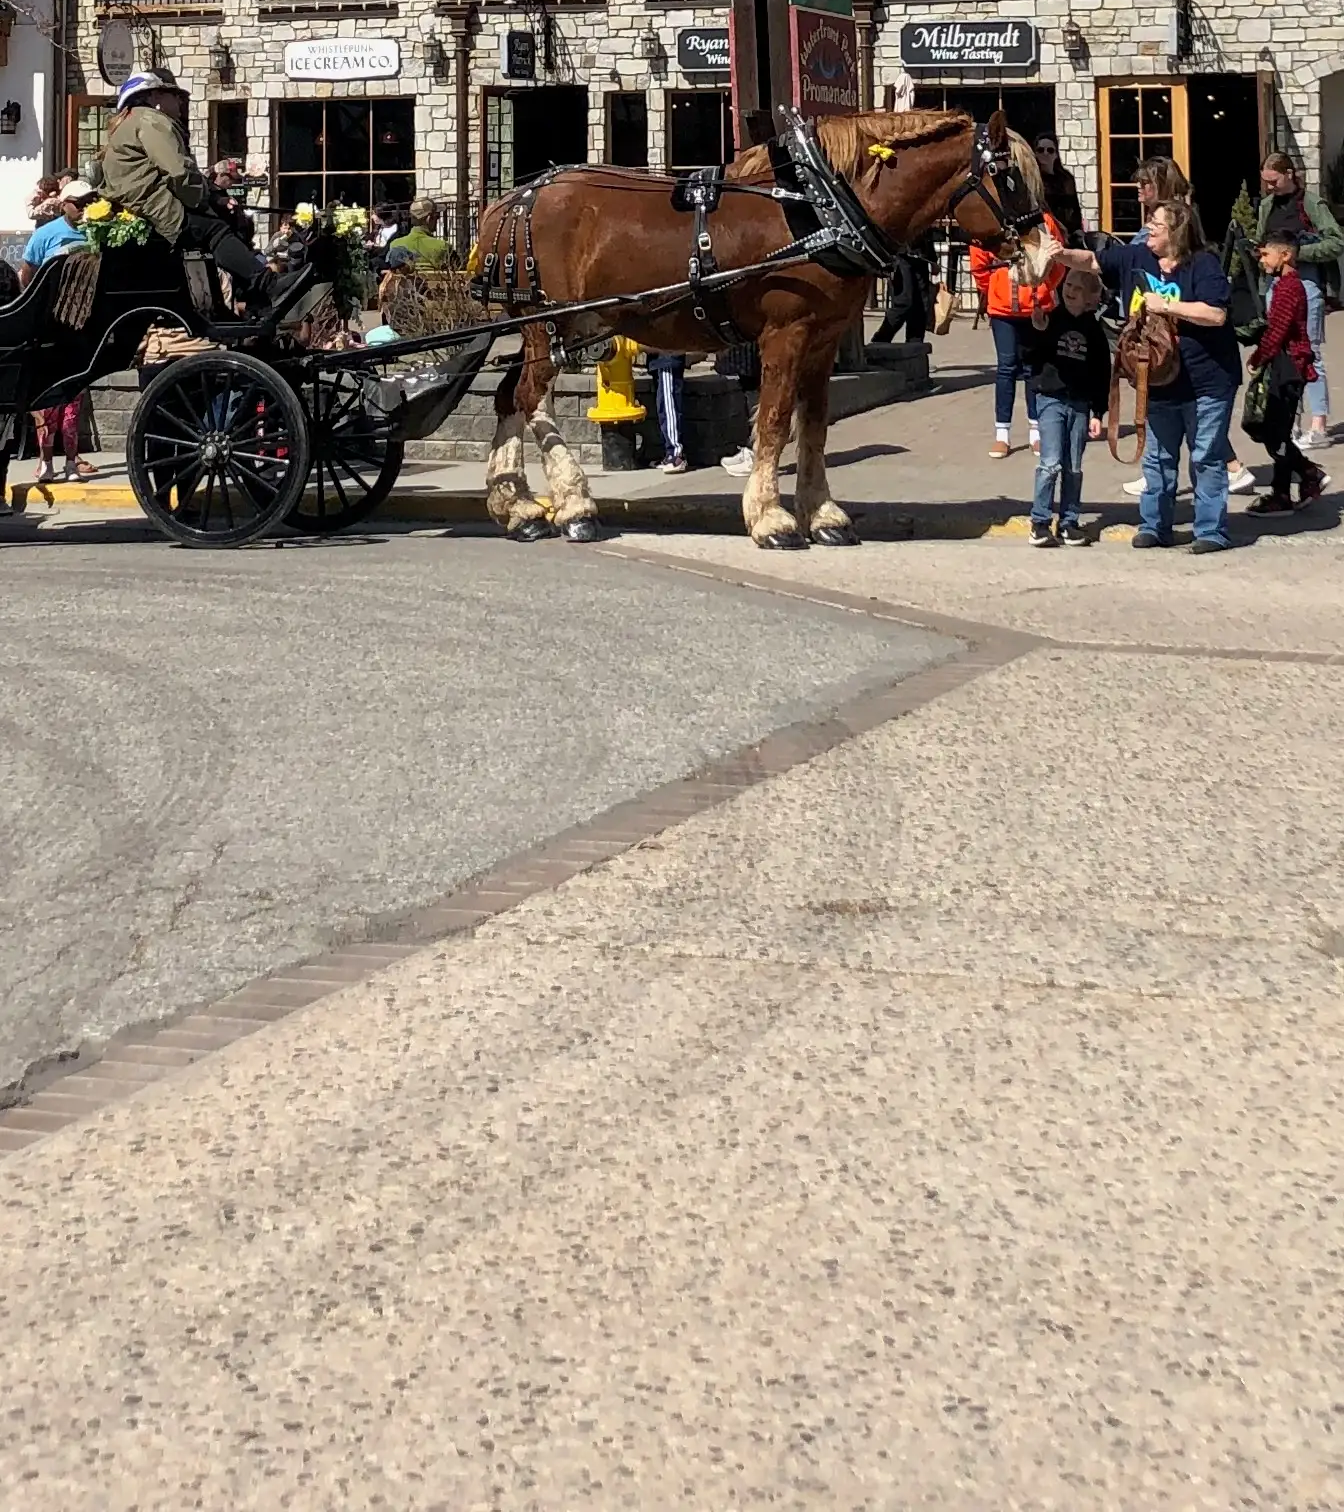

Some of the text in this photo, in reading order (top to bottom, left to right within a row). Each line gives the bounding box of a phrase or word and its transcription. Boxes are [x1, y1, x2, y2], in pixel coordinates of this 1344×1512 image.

[685, 35, 730, 56] Ryan
[800, 18, 839, 66] Waterfront
[911, 23, 1021, 48] Milbrandt
[307, 44, 375, 55] WHISTLEPUNK
[929, 47, 1004, 65] Wine Tasting
[290, 55, 393, 71] ICE CREAM CO.
[801, 74, 856, 107] Promenade
